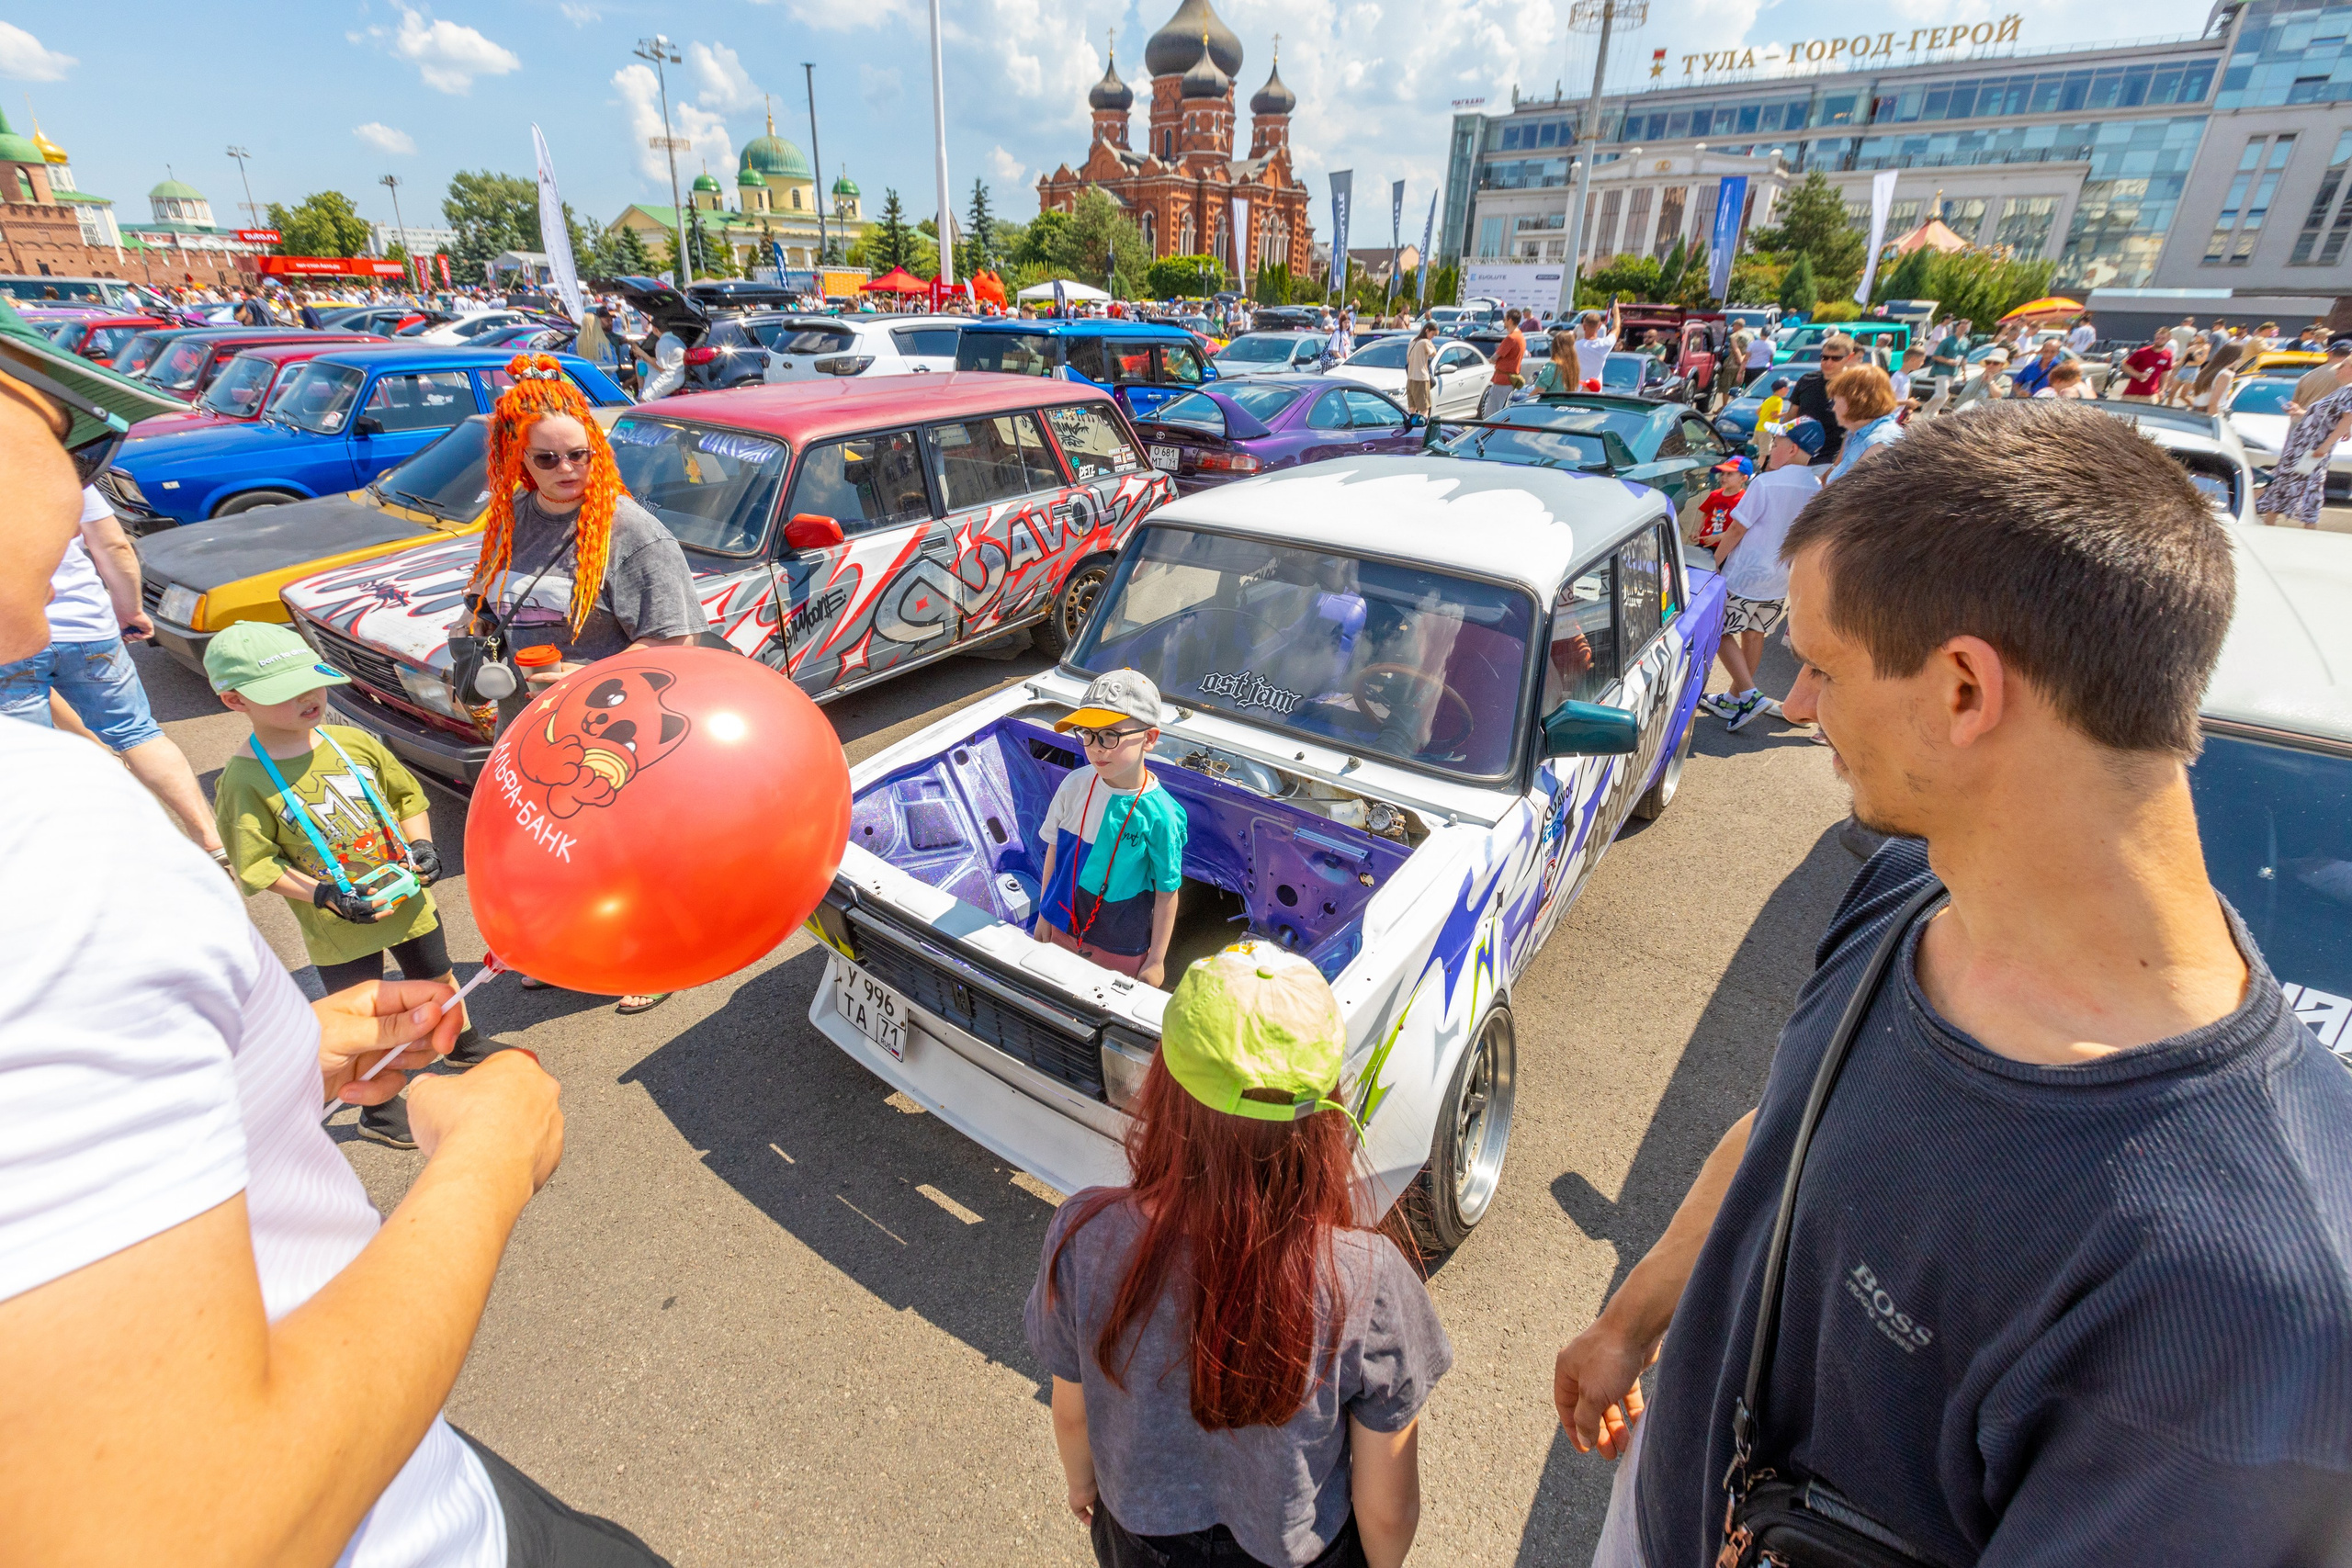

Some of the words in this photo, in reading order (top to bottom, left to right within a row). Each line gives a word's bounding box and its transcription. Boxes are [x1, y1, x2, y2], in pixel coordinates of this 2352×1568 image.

[1682, 49, 1756, 75] ТУЛА
[1787, 12, 2024, 64] ГОРОД-ГЕРОЙ
[1161, 447, 1175, 457] 681
[1168, 458, 1176, 467] 71
[258, 653, 279, 668] born
[279, 651, 291, 660] to
[1197, 671, 1251, 700] ost
[1236, 675, 1303, 715] jam
[494, 741, 577, 863] АЛЬФА-БАНК
[847, 965, 858, 988] У
[864, 978, 895, 1017] 996
[844, 992, 867, 1030] ТА
[881, 1018, 898, 1046] 71
[880, 1037, 892, 1051] RUS
[1851, 1264, 1934, 1347] BOSS
